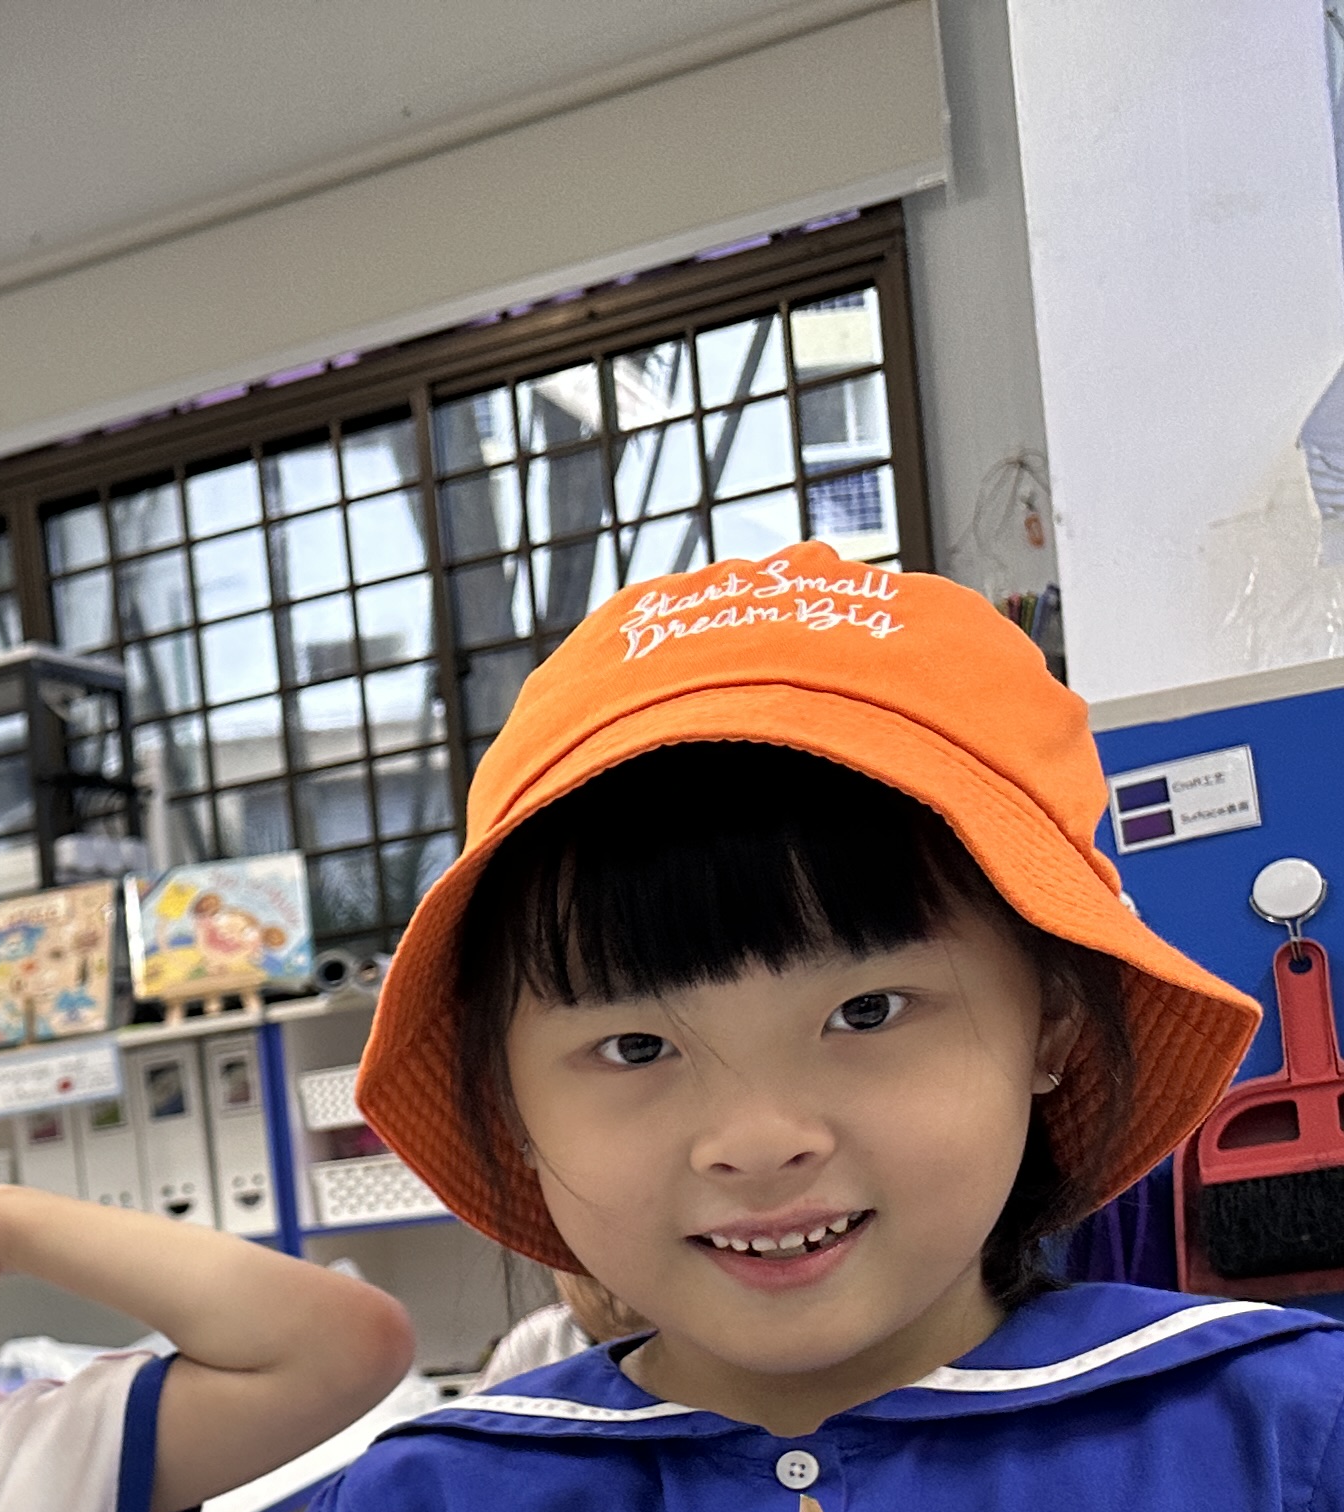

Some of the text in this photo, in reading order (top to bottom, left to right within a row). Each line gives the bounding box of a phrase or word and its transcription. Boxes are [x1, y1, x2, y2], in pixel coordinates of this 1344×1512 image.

[619, 560, 899, 633] Start Small
[621, 598, 905, 662] Dream Big
